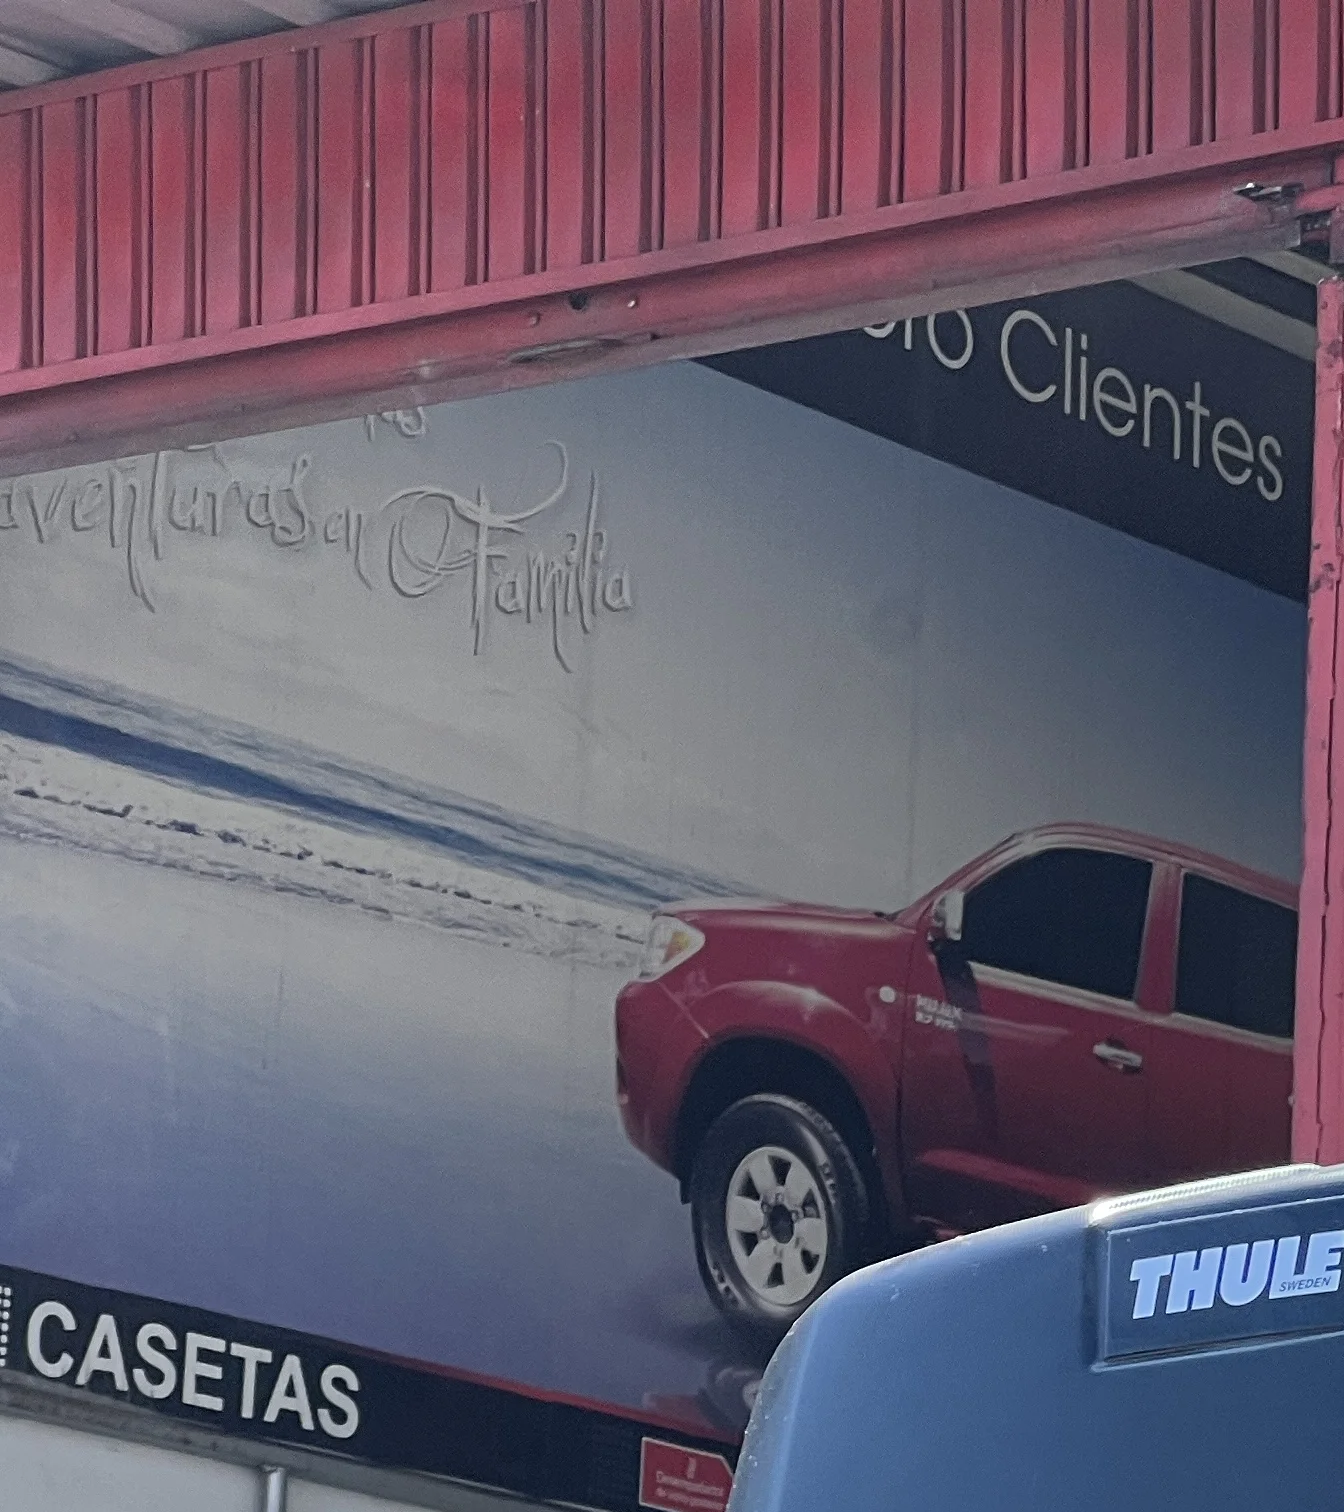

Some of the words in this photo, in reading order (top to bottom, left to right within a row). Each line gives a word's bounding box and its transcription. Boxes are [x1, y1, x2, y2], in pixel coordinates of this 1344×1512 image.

[1000, 310, 1284, 501] Clientes
[1278, 1275, 1333, 1293] SWEDEN
[26, 1300, 361, 1439] CASETAS
